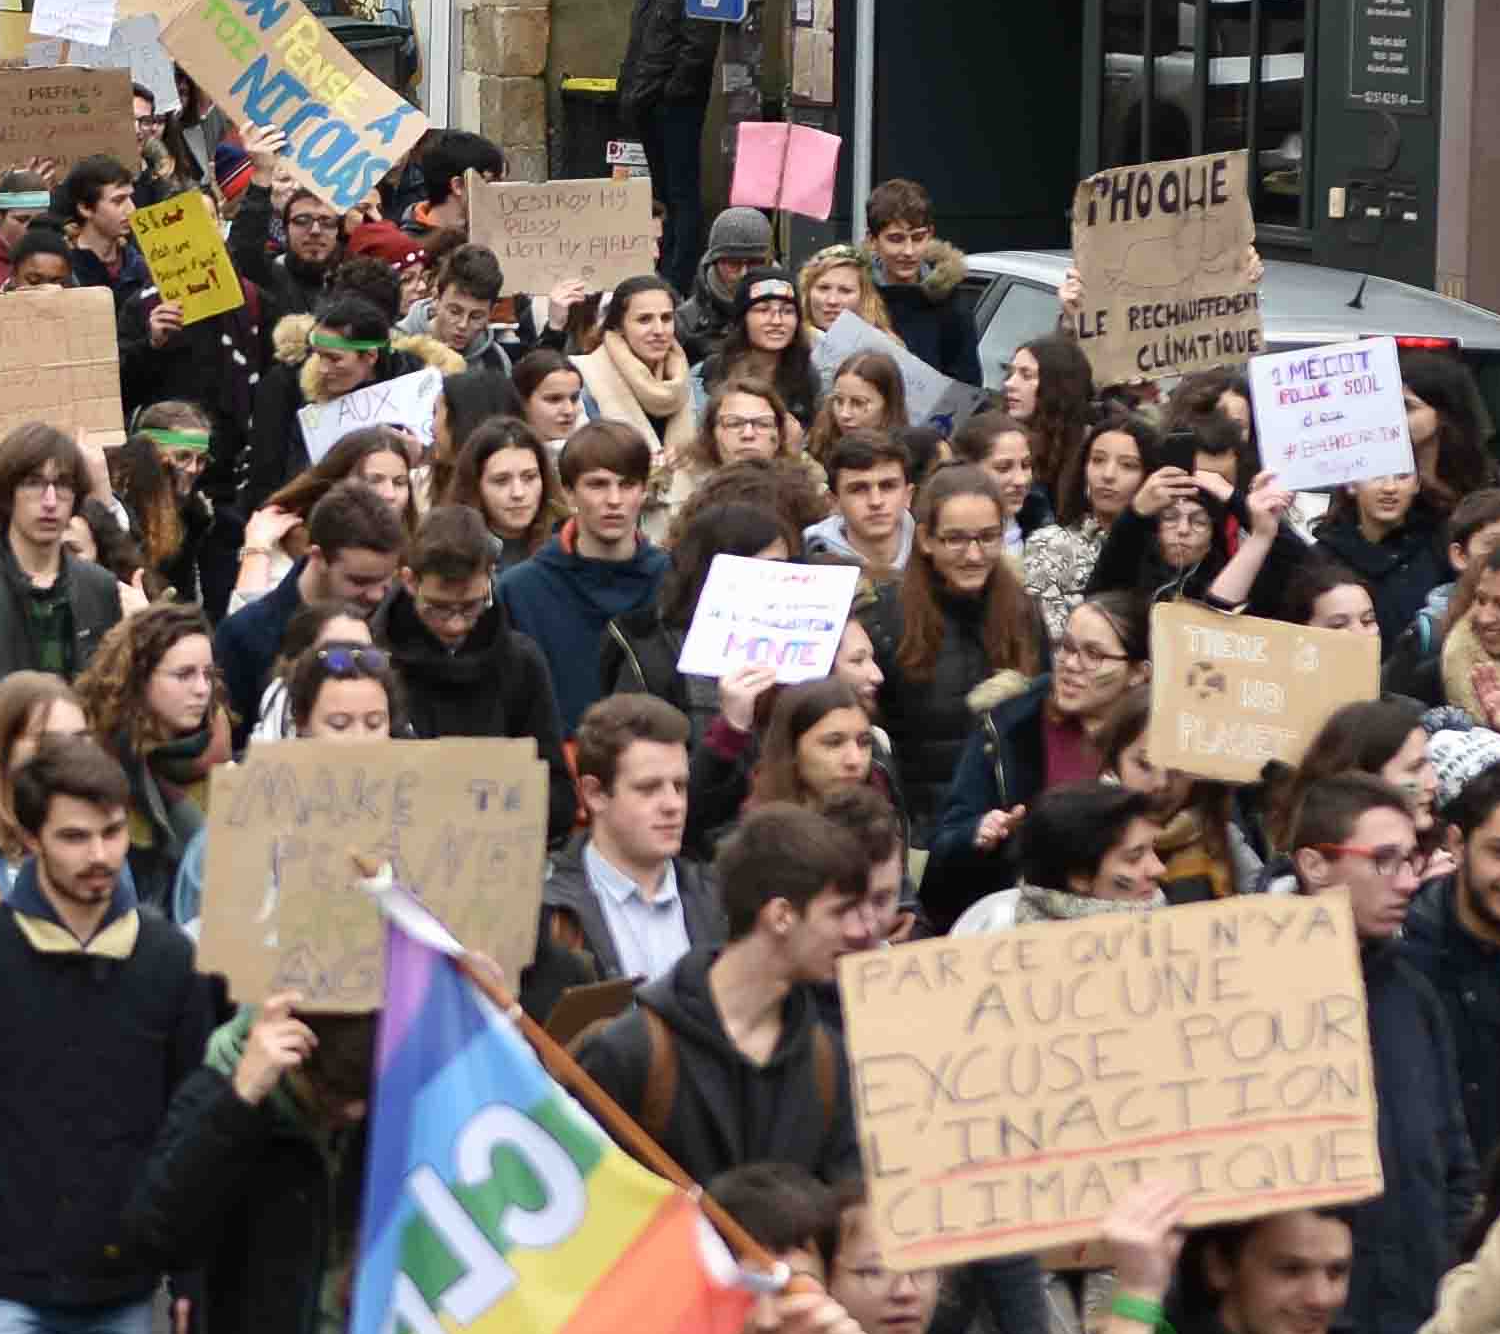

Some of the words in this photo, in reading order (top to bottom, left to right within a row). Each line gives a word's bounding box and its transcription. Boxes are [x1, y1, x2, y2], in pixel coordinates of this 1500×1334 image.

[1077, 310, 1108, 340] LE
[855, 947, 965, 1004] PAR
[989, 936, 1041, 978] CE
[963, 954, 1252, 1037] AUCUNE
[858, 1026, 1148, 1119] EXCUSE
[1175, 992, 1363, 1073] POUR
[870, 1059, 1363, 1181] L'INACTION
